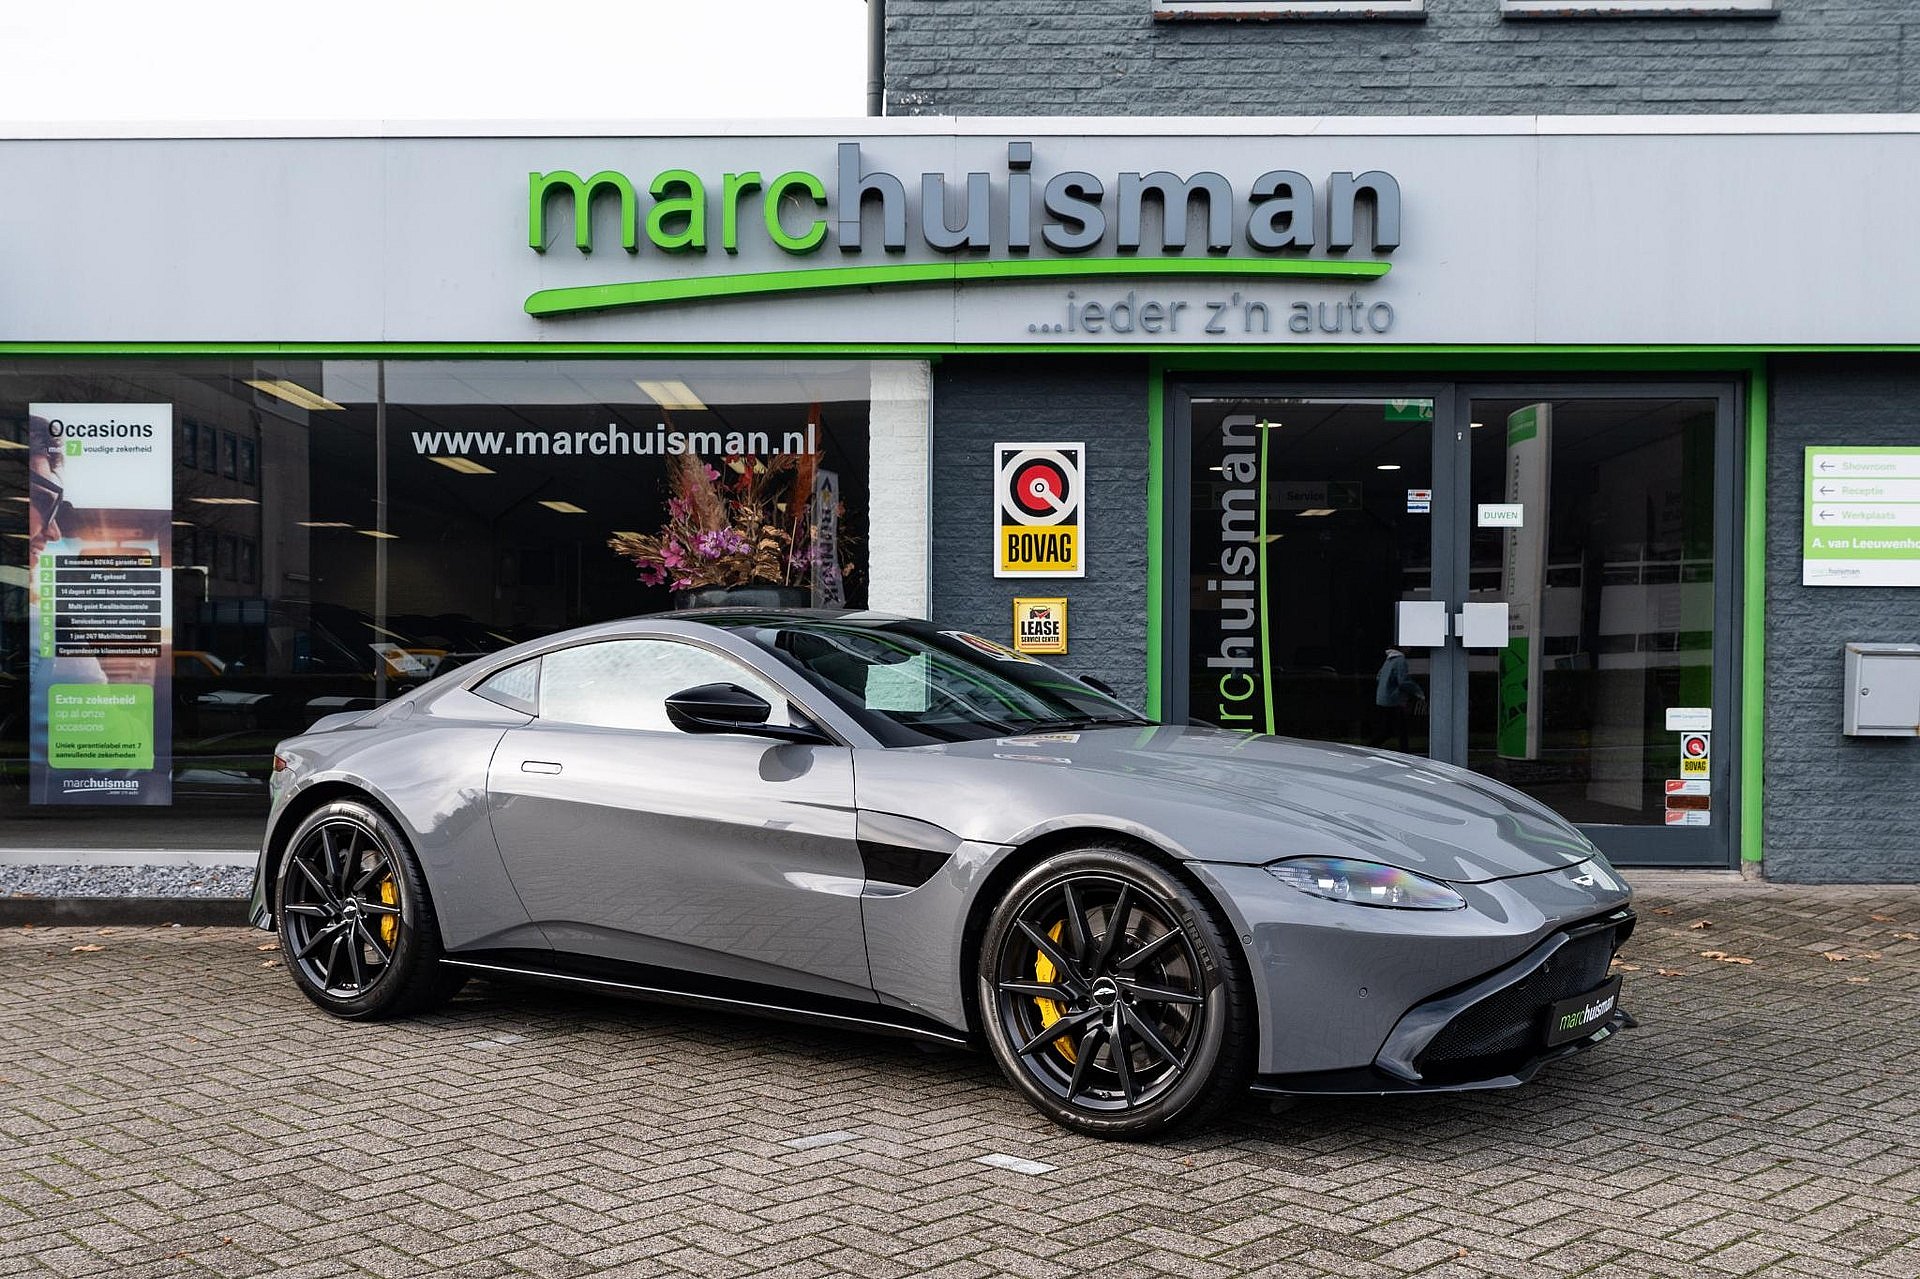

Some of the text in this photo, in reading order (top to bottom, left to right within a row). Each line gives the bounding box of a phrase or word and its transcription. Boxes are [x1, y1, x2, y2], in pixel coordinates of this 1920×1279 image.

[528, 141, 1401, 255] marchuisman
[1205, 292, 1269, 333] z'n
[1288, 293, 1395, 333] auto
[49, 419, 153, 438] Occasions
[411, 423, 816, 455] www.marchuisman.nl
[83, 445, 114, 455] voudige
[116, 444, 152, 453] zekerheid
[1287, 491, 1324, 501] Service
[1842, 486, 1884, 496] Receptie
[1484, 511, 1518, 519] DUWEN
[1842, 511, 1896, 521] Werkplaats
[1008, 533, 1071, 563] BOVAG
[1812, 537, 1824, 549] A.
[1828, 540, 1849, 549] van
[1207, 414, 1256, 733] rchuisman
[1020, 620, 1059, 636] LEASE
[55, 694, 136, 705] Extra zekerheid
[55, 711, 68, 720] op
[70, 709, 81, 718] al
[55, 723, 105, 732] occasions
[76, 741, 121, 750] garantielabel
[55, 751, 136, 759] aanvullende zekerheden
[1684, 760, 1706, 771] BOVAG
[63, 777, 139, 789] marchuisman
[1559, 995, 1615, 1031] marchuisman
